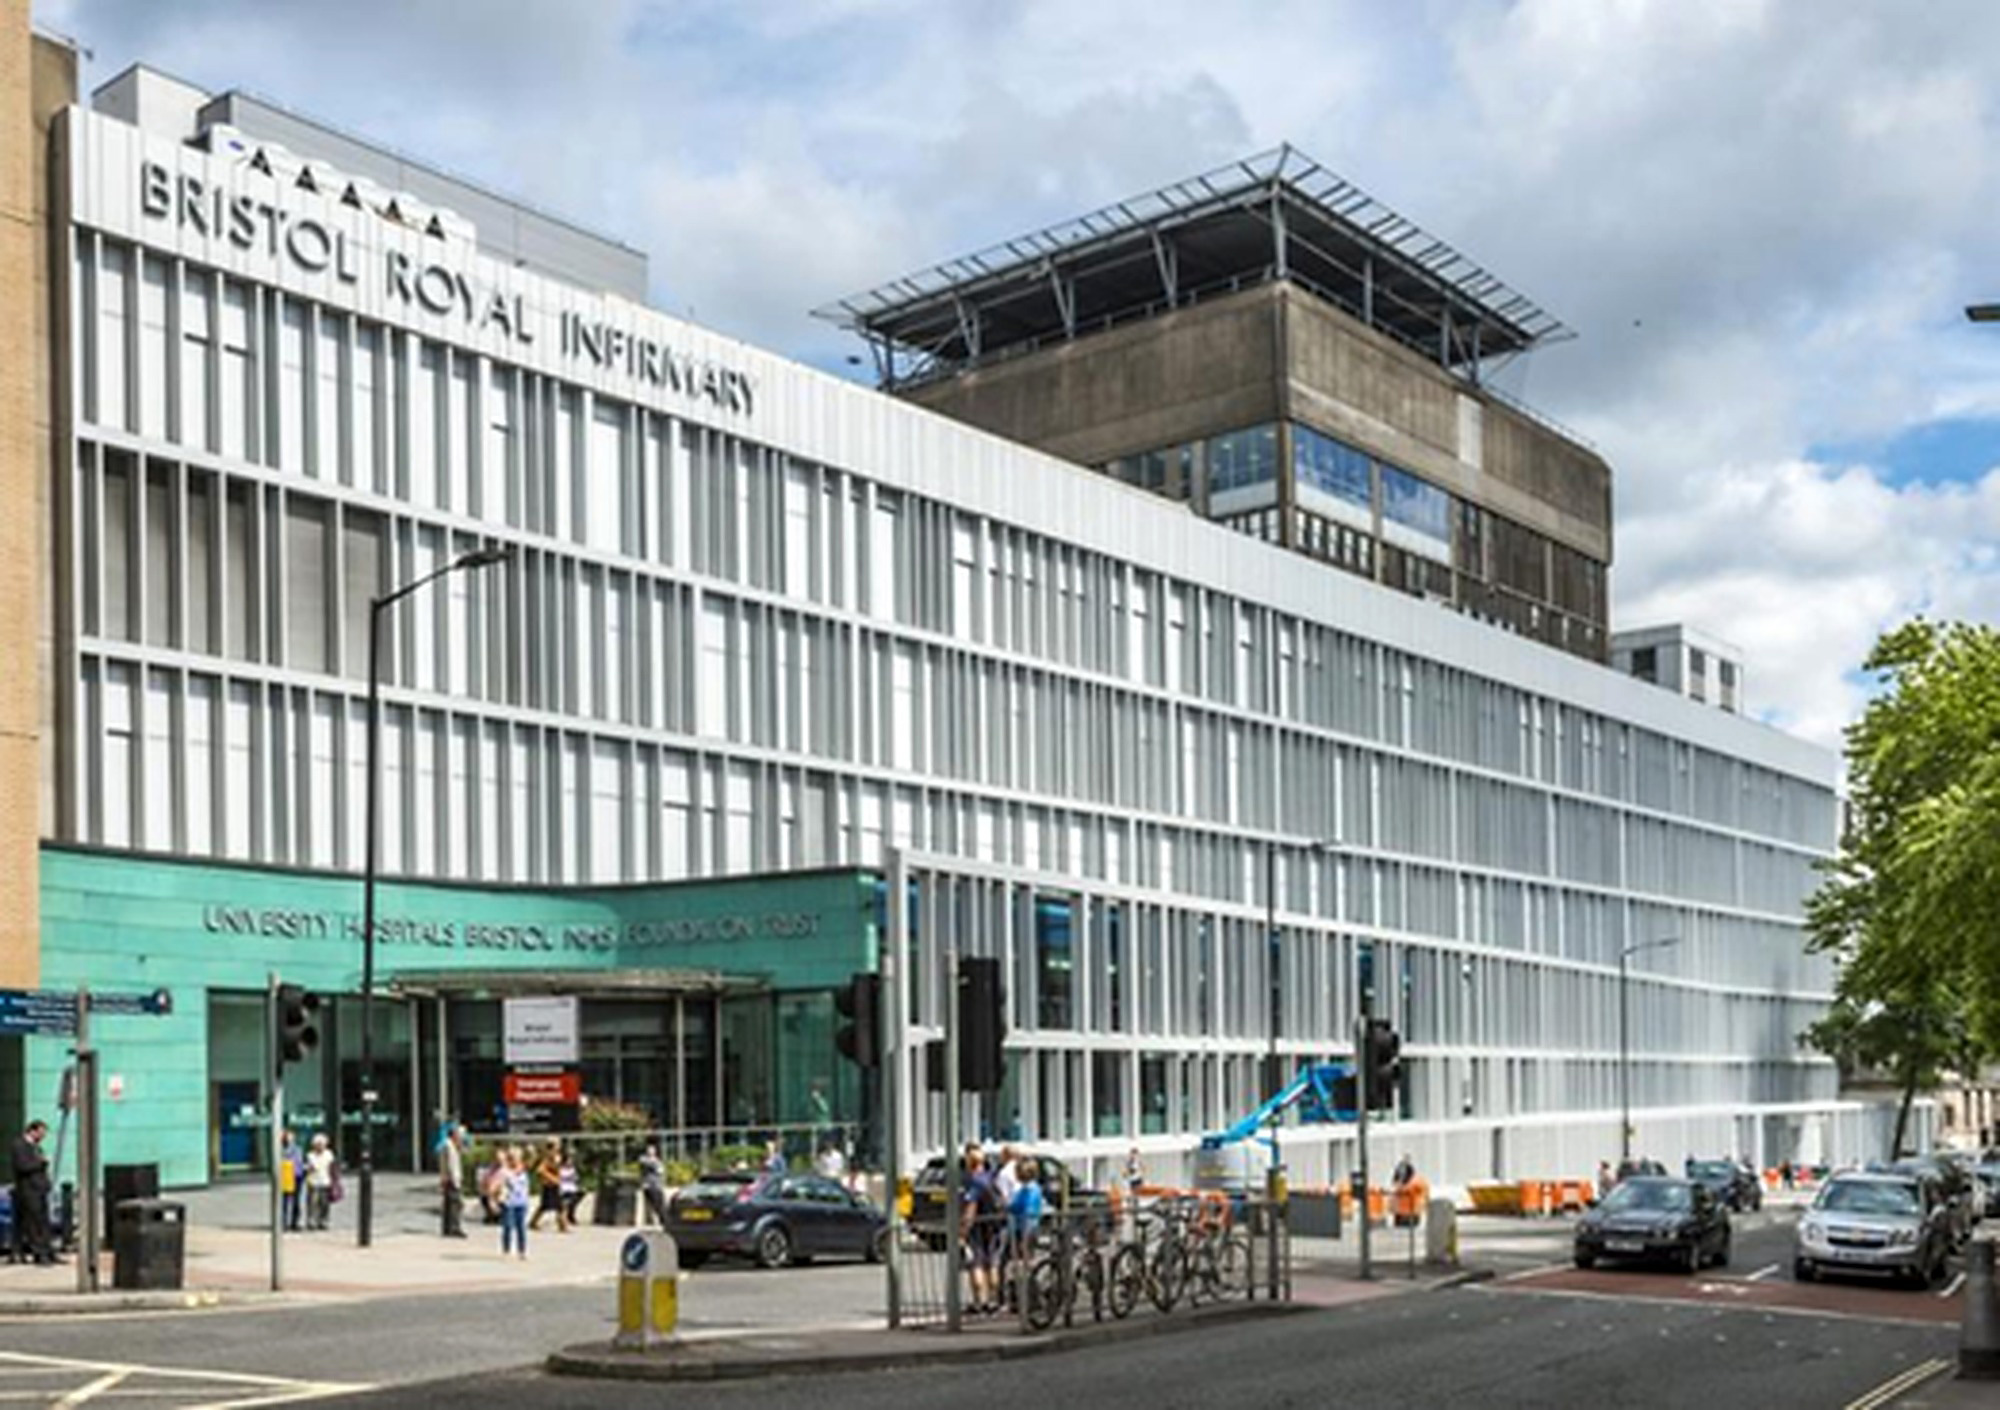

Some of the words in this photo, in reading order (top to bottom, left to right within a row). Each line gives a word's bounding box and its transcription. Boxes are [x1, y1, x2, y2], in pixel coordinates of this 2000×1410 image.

[140, 160, 359, 286] BRISTOL
[386, 249, 534, 346] ROYAL
[561, 309, 758, 416] INFIRMARY
[203, 903, 329, 940] UNIVERSITY
[465, 918, 554, 952] BRISTOL
[562, 924, 617, 952] NHS
[761, 911, 821, 941] TRUST
